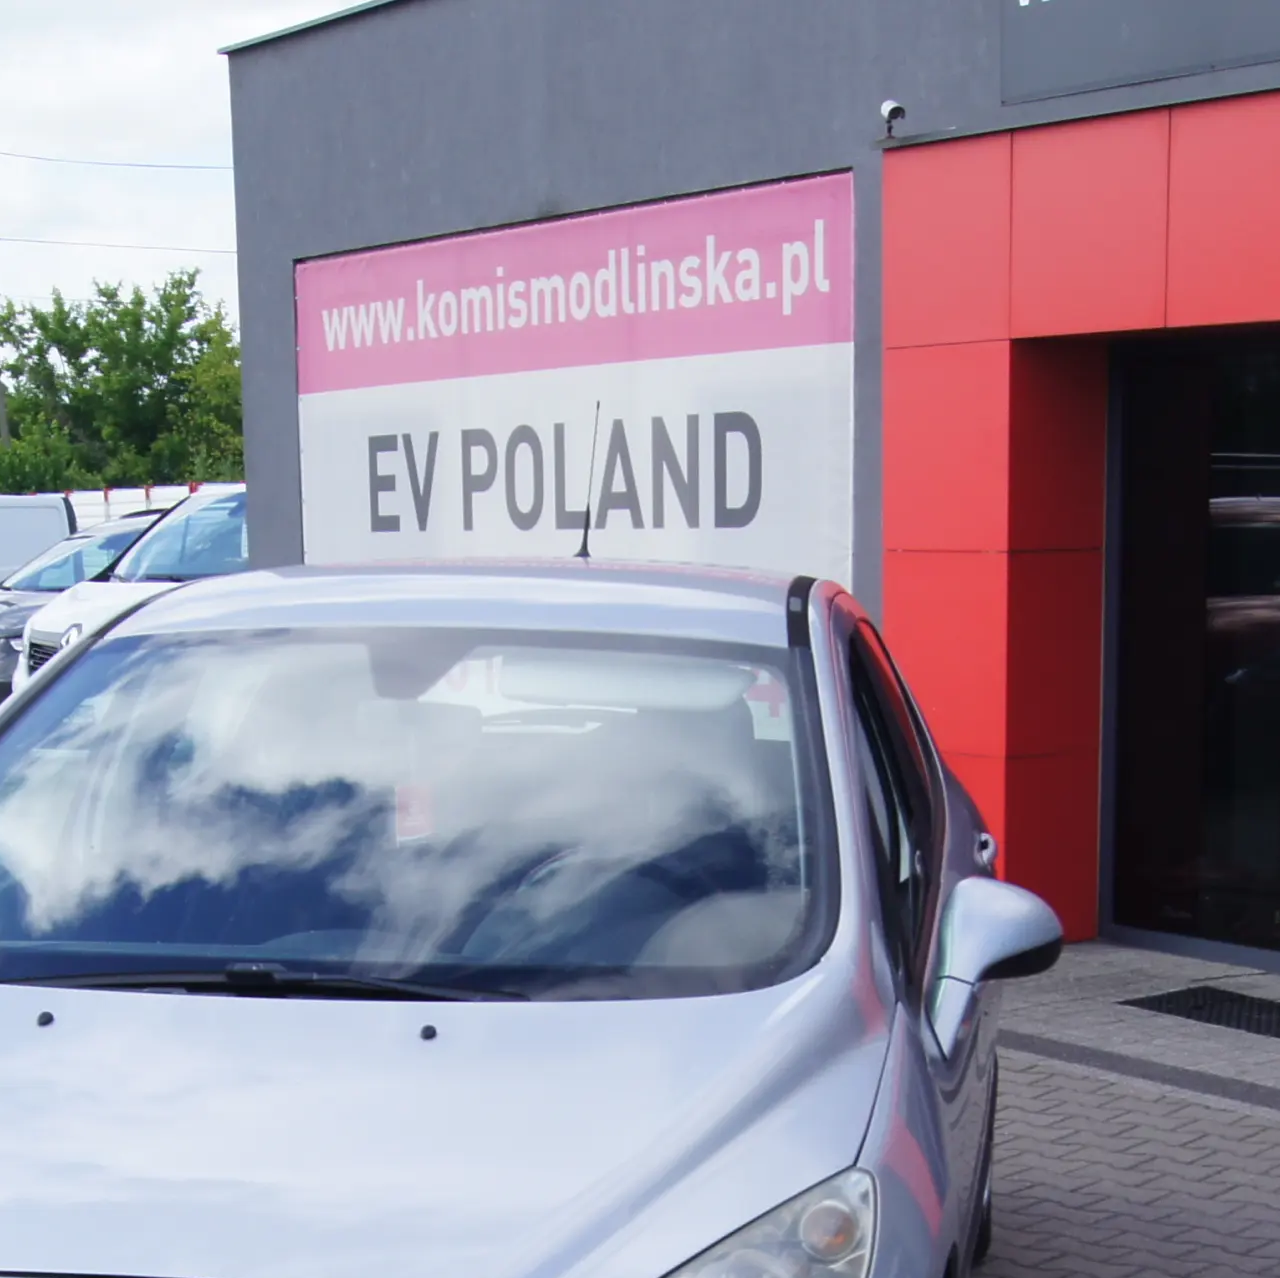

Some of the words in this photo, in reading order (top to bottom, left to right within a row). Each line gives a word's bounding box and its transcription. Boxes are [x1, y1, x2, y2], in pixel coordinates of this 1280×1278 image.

[322, 219, 830, 351] www.komismodlinska.pl
[368, 431, 440, 533] EV
[461, 411, 763, 531] POLAND
